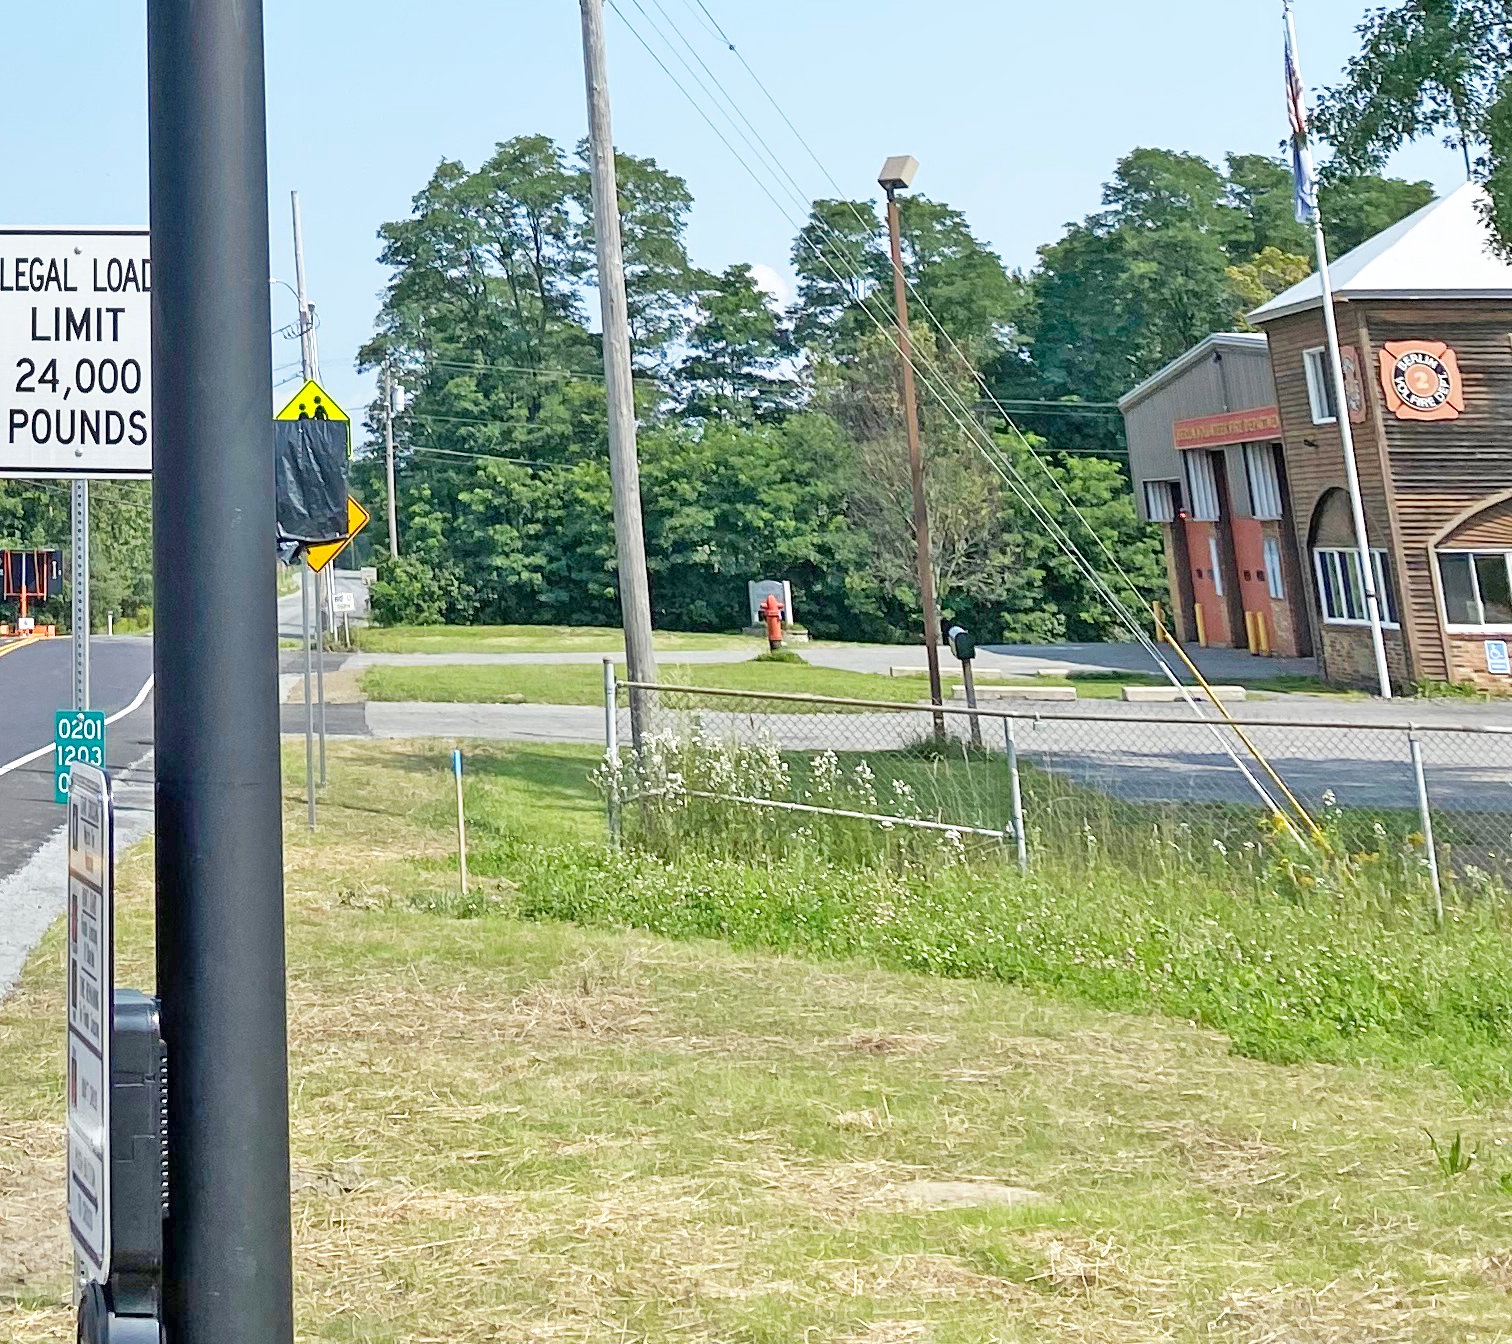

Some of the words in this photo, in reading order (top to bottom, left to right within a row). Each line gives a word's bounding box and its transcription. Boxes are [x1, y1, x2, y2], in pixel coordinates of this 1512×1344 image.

[0, 257, 78, 292] LEGAL
[31, 307, 126, 342] LIMIT
[1397, 353, 1438, 371] BERLIN
[15, 358, 142, 401] 24,000
[1414, 371, 1430, 390] 2
[1409, 395, 1438, 408] FIRE
[8, 408, 148, 446] POUNDS
[58, 718, 101, 740] 0201
[58, 746, 102, 766] 1203
